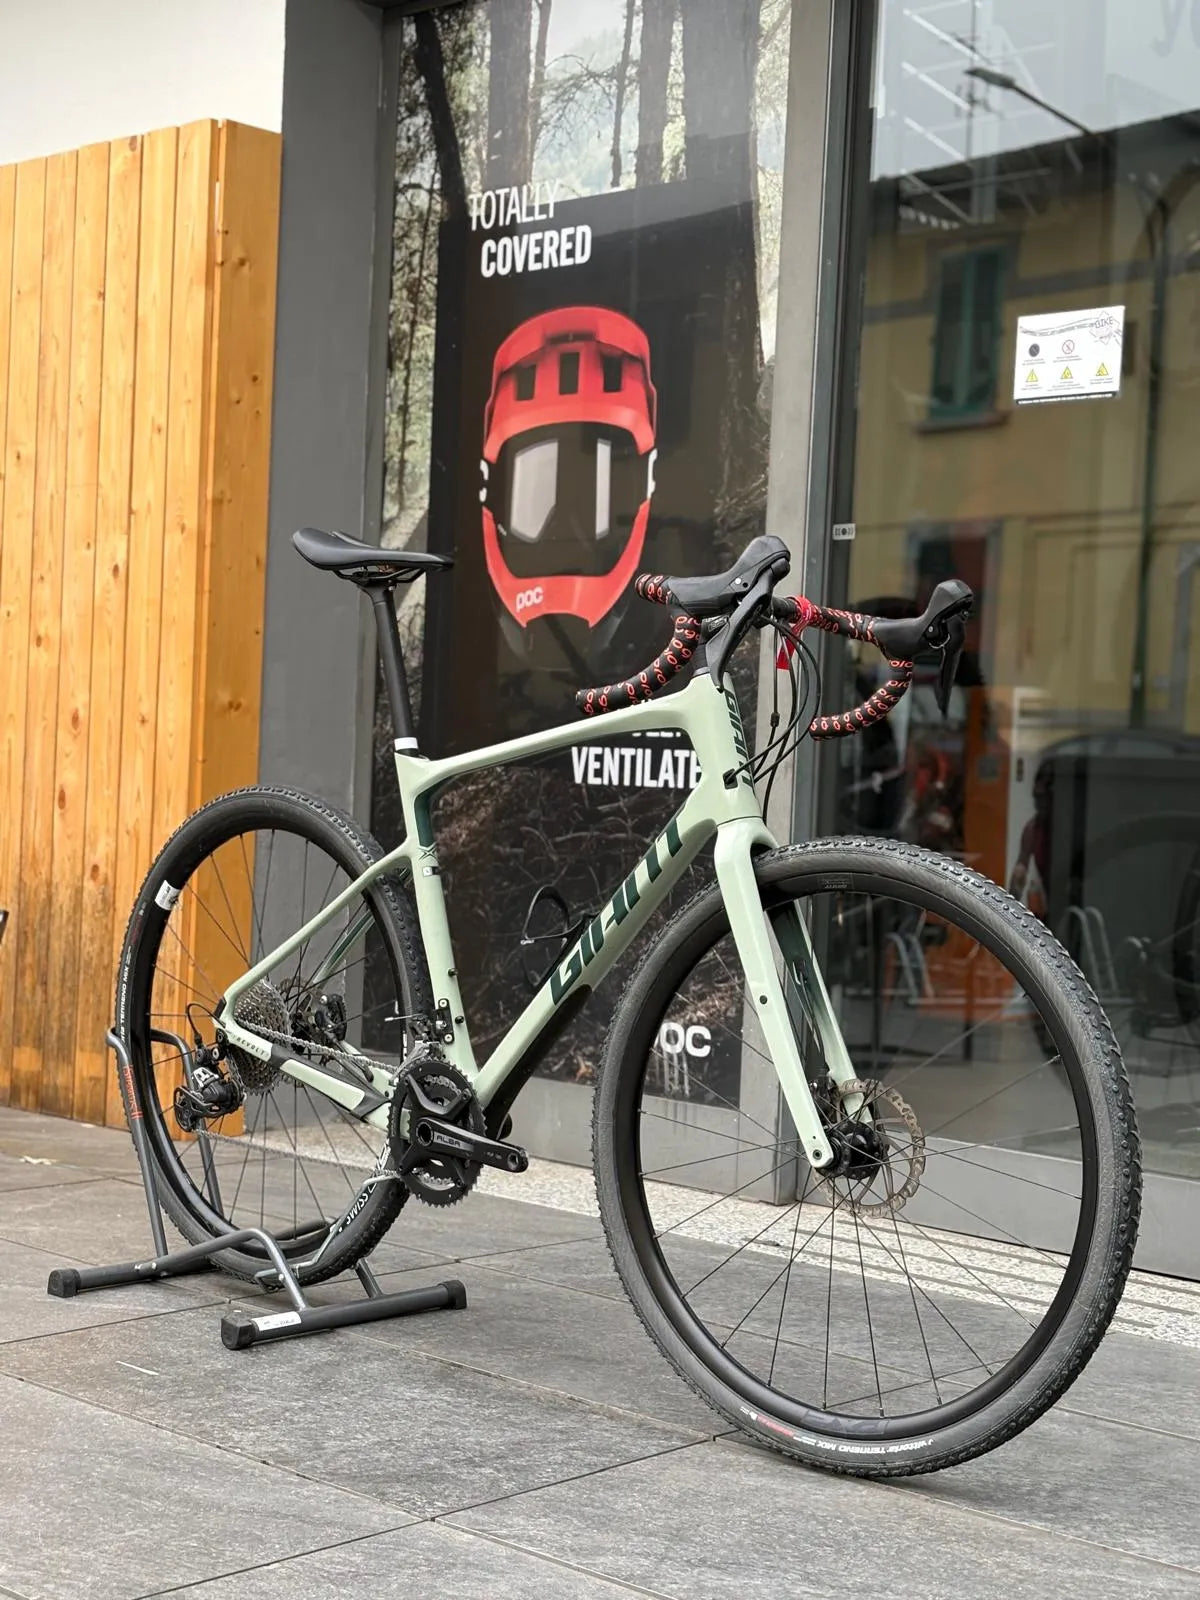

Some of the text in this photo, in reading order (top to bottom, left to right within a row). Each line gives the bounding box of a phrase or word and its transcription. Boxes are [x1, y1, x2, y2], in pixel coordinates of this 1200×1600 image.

[468, 180, 560, 231] TOTALLY
[481, 224, 592, 278] COVERED
[236, 1036, 265, 1056] REVOLT
[436, 1134, 461, 1147] ALBA
